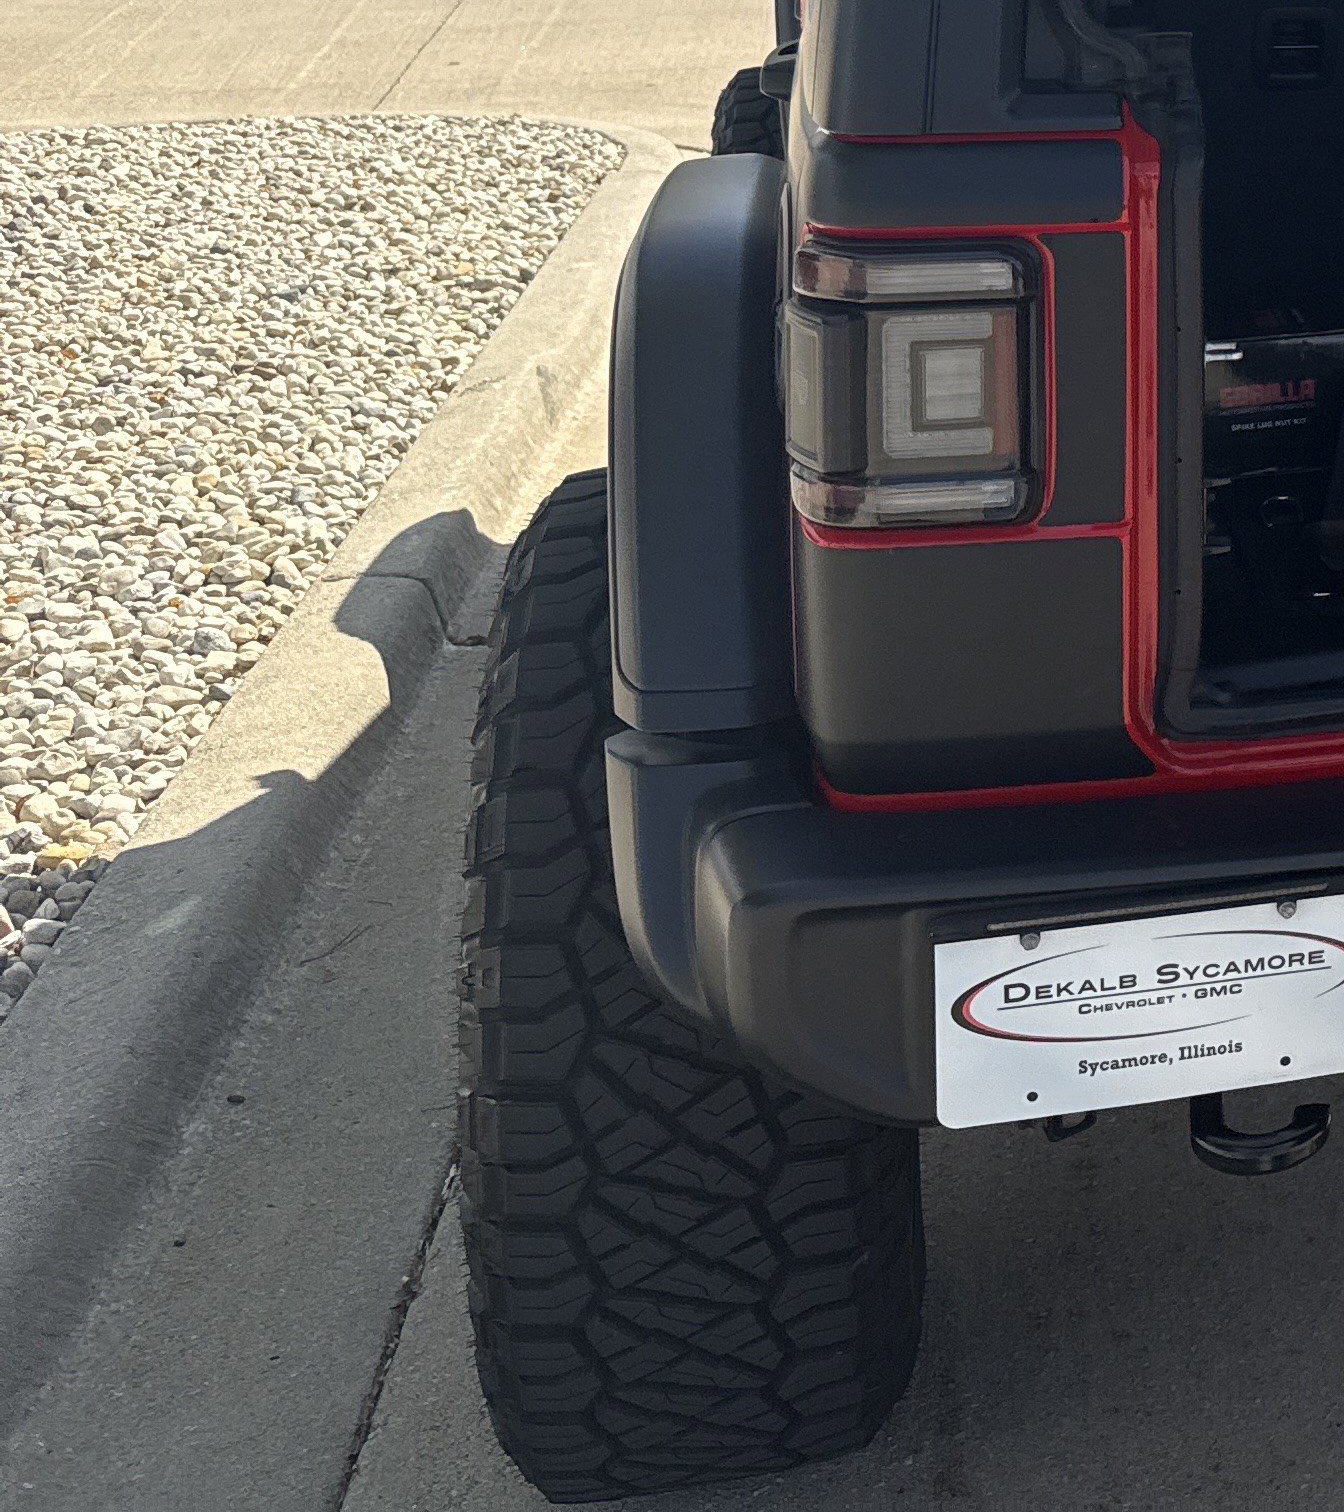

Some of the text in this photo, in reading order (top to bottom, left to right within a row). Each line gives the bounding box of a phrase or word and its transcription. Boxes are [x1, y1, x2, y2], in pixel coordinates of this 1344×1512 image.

[1078, 983, 1244, 1015] CHEVROLET GMC
[1078, 1039, 1243, 1075] Sycamore, Illinois
